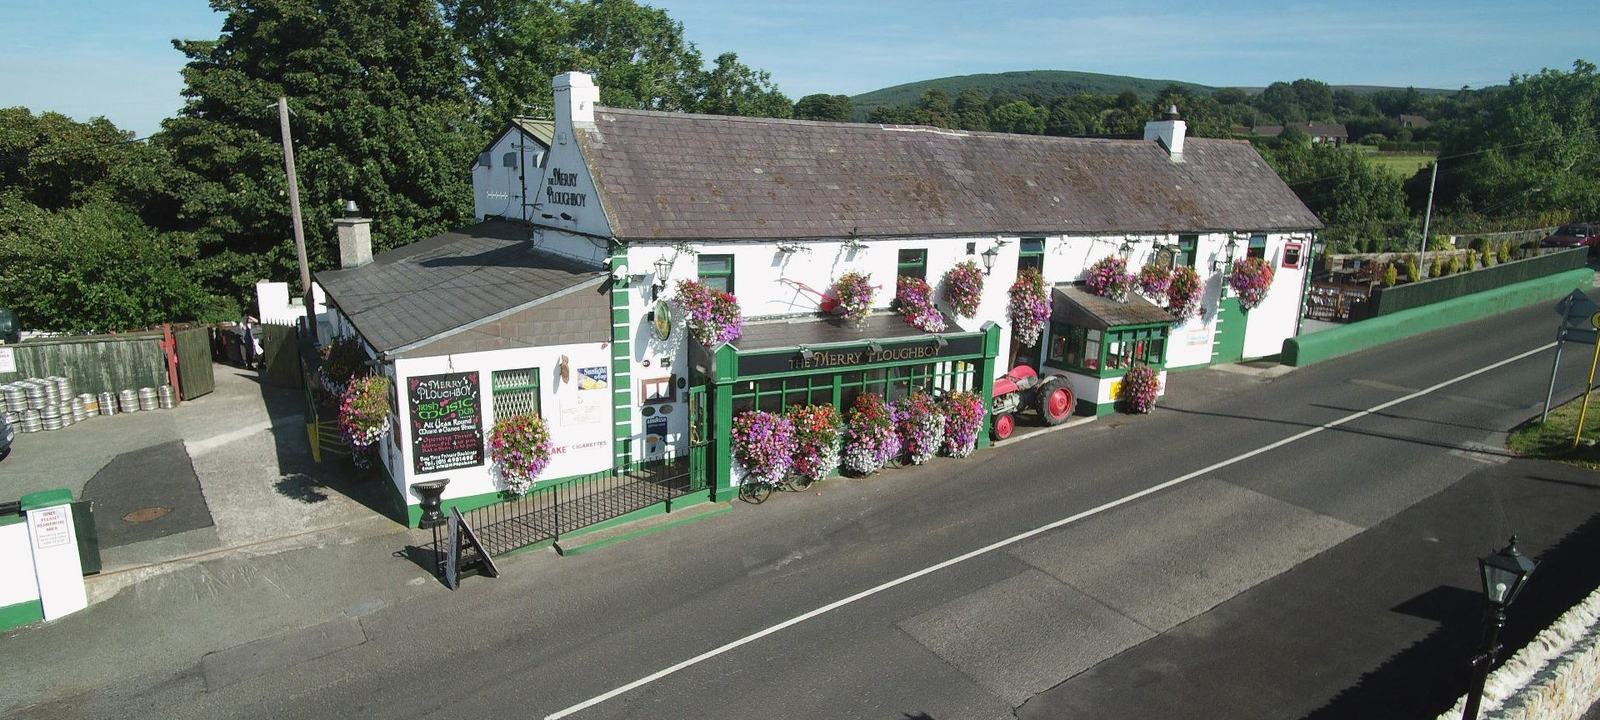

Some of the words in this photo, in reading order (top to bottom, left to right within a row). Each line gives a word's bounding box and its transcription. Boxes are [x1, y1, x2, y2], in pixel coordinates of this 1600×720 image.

[553, 167, 578, 188] MERRY
[546, 185, 587, 208] PLOUGHBOY
[787, 357, 811, 370] THE
[812, 350, 863, 368] MERRY
[867, 345, 942, 363] PLOUGHBOY
[417, 383, 472, 399] PLOUGHBOY
[429, 380, 462, 389] MERRY
[551, 446, 567, 455] AKE
